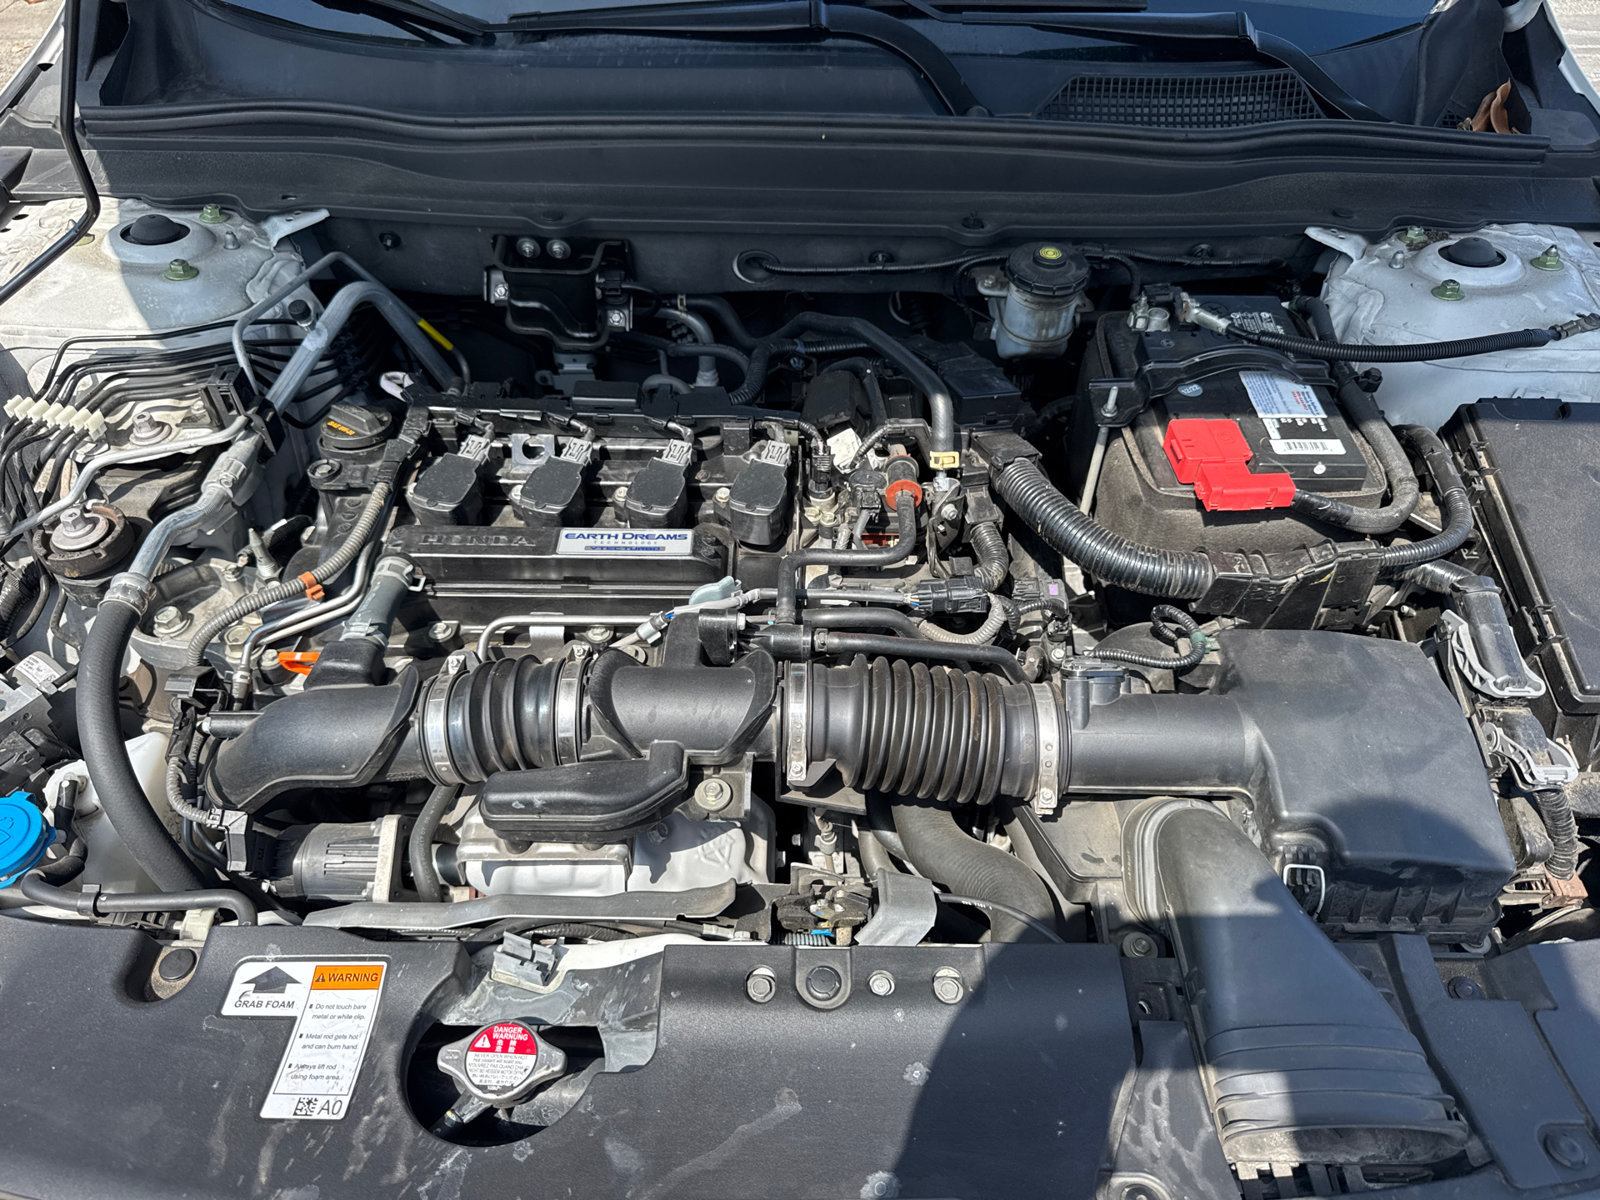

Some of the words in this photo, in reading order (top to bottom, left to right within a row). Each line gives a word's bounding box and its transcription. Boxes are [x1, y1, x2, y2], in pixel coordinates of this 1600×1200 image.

[419, 534, 536, 546] HONDA
[564, 532, 619, 541] EARTH
[622, 532, 688, 541] DREAMS
[328, 972, 378, 982] WARNING
[234, 1000, 263, 1009] GRAB
[265, 1000, 295, 1009] FOAM
[493, 1026, 524, 1034] DANGER
[492, 1033, 528, 1041] WARNUNG
[317, 1099, 343, 1116] A0
